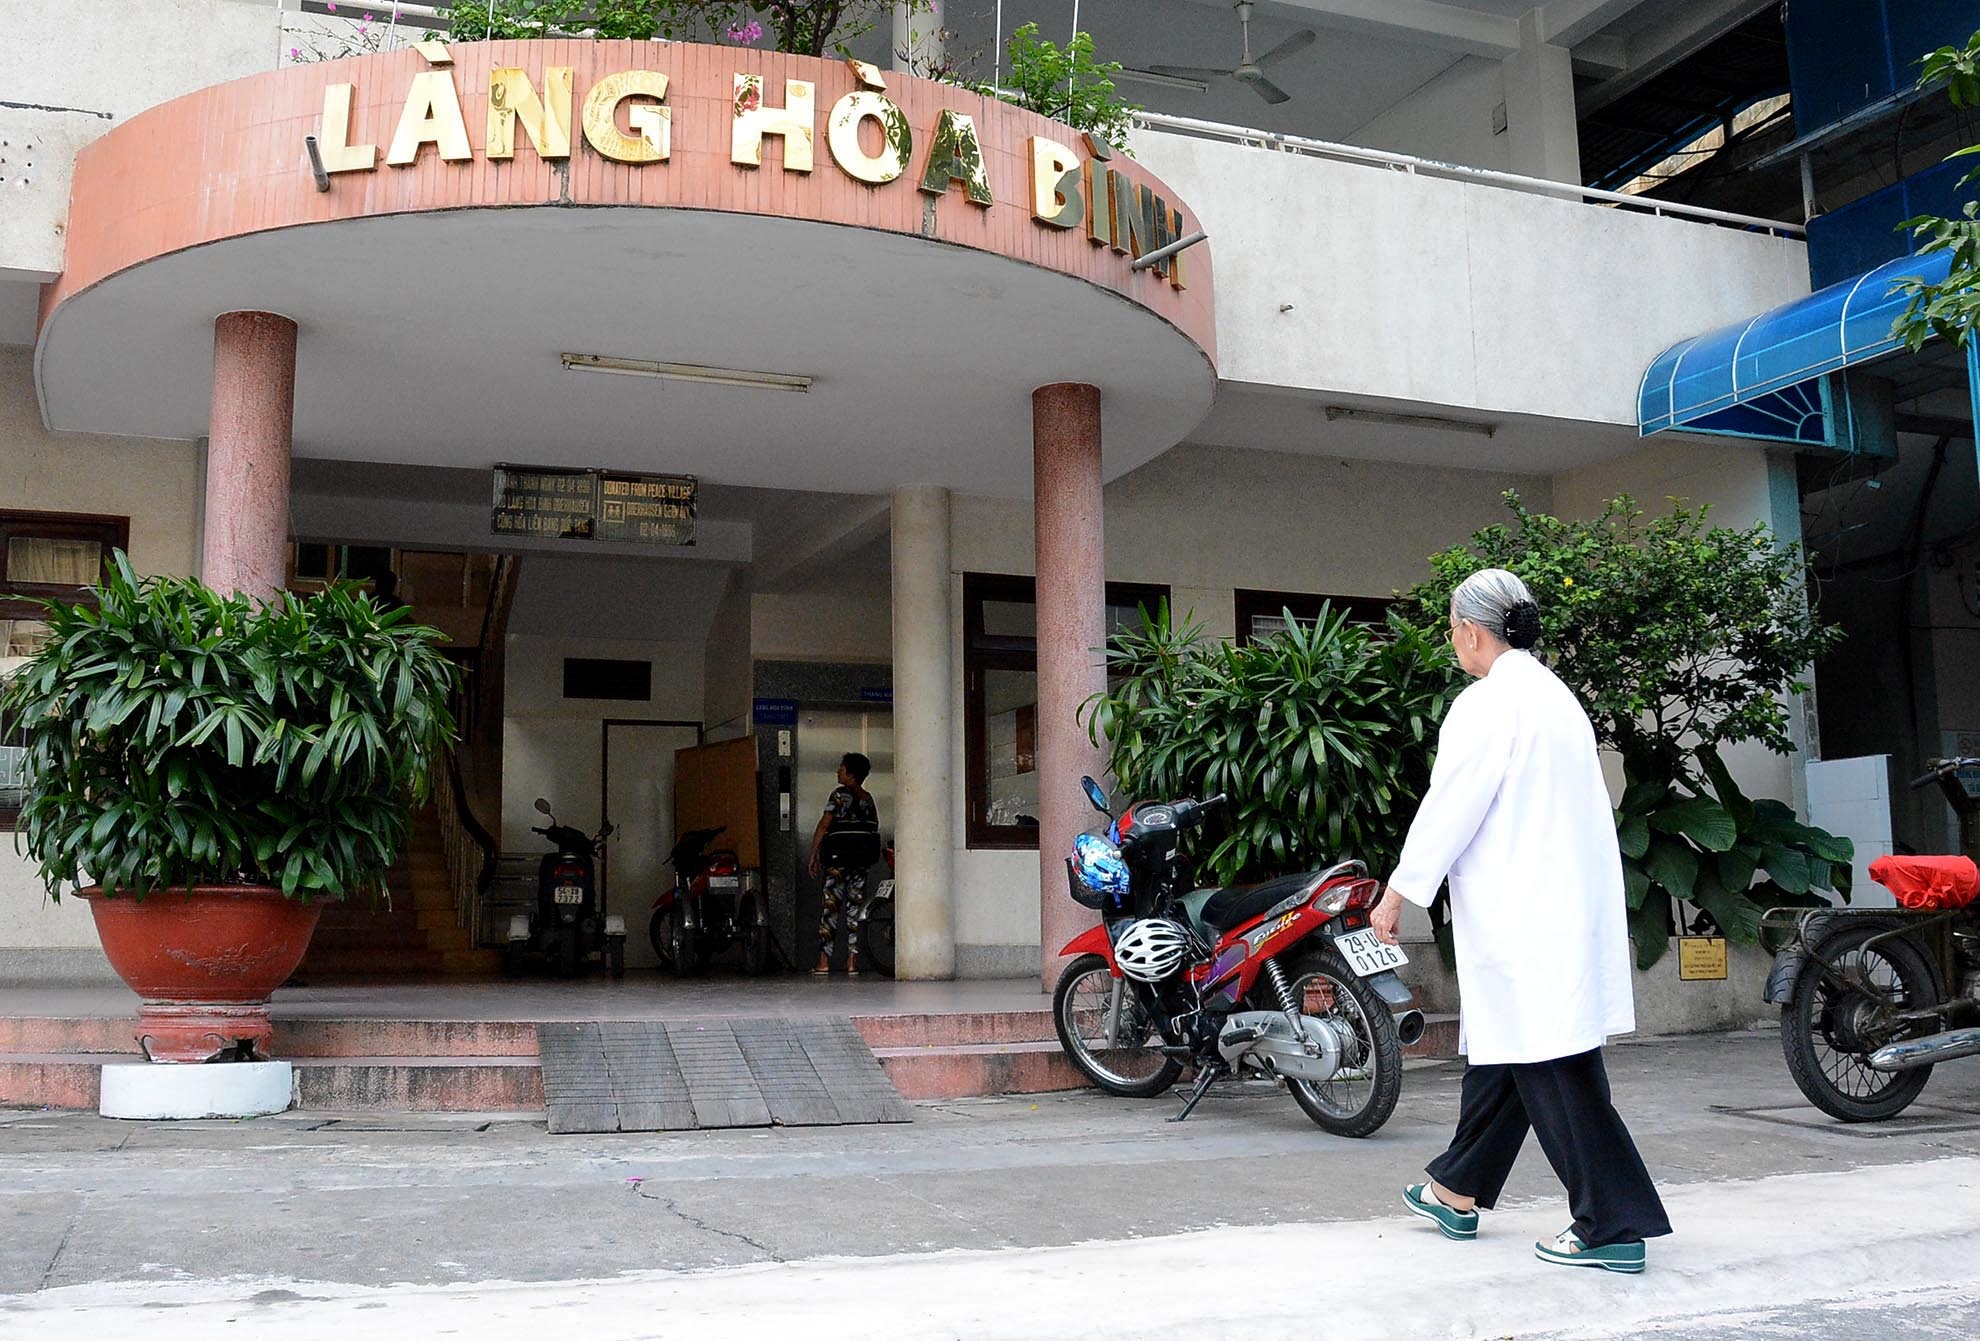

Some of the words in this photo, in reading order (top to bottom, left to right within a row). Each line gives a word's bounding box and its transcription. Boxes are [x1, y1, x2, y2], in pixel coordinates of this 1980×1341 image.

[318, 42, 672, 174] LÀNG
[730, 58, 993, 208] HÒA
[1028, 132, 1186, 290] BÌNH
[603, 480, 631, 496] DONATED
[631, 482, 647, 498] FROM
[647, 483, 666, 499] PEACE
[667, 484, 692, 501] VILLAGE
[627, 501, 663, 517] OBERHAUSEN
[1355, 948, 1398, 972] 0126
